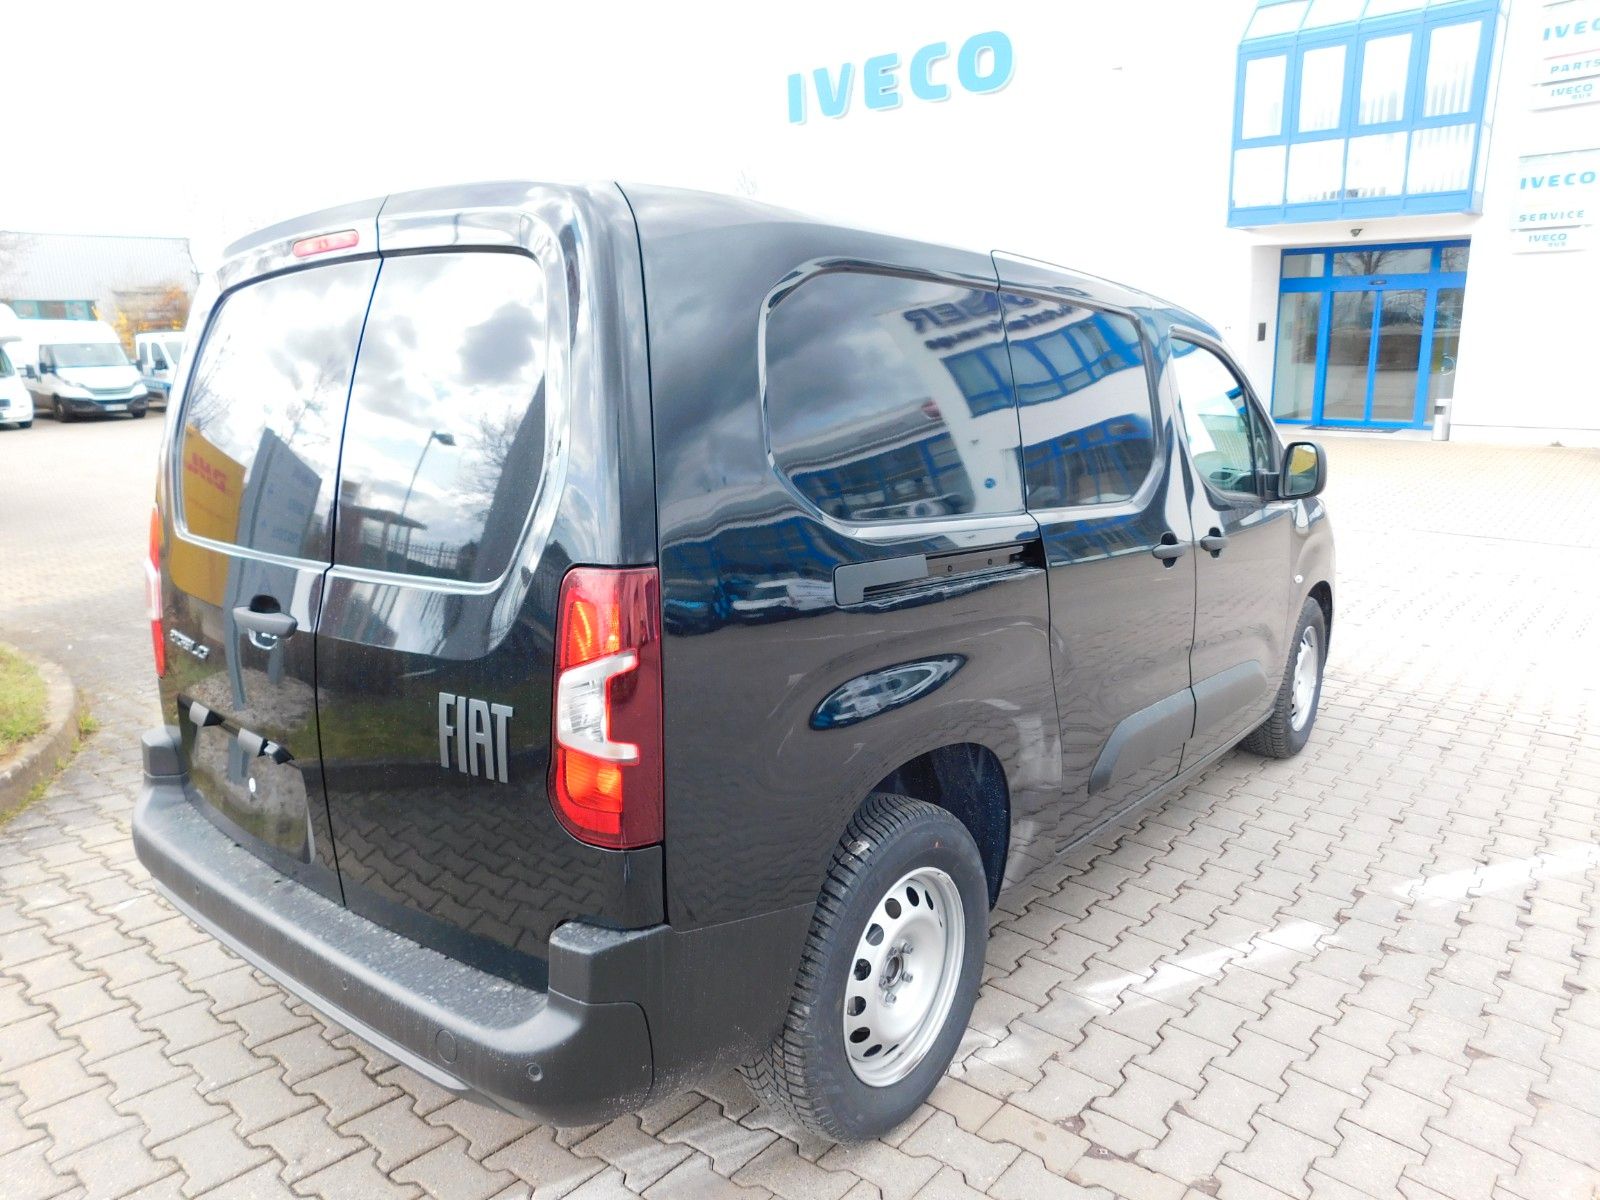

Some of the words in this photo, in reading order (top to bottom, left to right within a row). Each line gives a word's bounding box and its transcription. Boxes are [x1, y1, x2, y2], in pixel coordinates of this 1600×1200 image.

[787, 30, 1015, 123] IVECO
[1551, 83, 1593, 97] IVECO
[1519, 170, 1597, 190] IVECO
[1519, 209, 1585, 223] SERVICE
[1528, 233, 1568, 243] IVECO
[438, 691, 514, 784] FIAT
